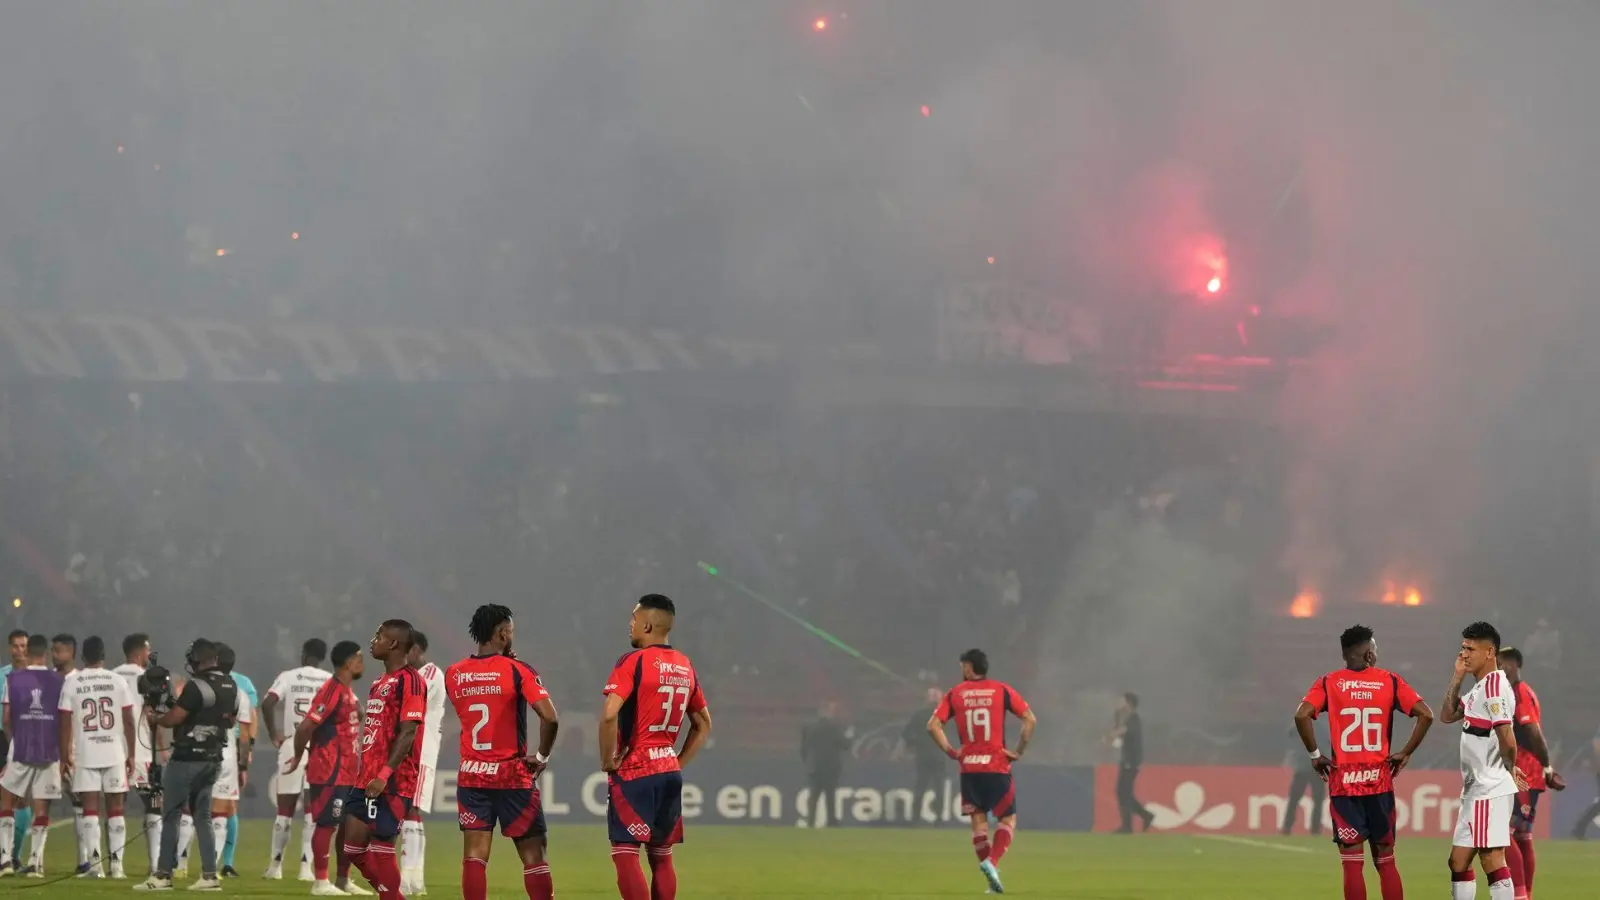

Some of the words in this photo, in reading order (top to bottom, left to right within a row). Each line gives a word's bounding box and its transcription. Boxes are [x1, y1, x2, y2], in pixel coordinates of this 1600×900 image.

[461, 685, 502, 697] CHAVERRA
[1342, 680, 1360, 692] JFK
[1351, 691, 1373, 700] MENA
[81, 697, 115, 732] 26
[648, 686, 690, 733] 33
[964, 708, 990, 742] 19
[468, 703, 492, 751] 2
[1340, 707, 1383, 753] 26
[460, 760, 500, 775] MAPEI
[1342, 769, 1380, 784] MAPEI
[716, 784, 782, 819] en
